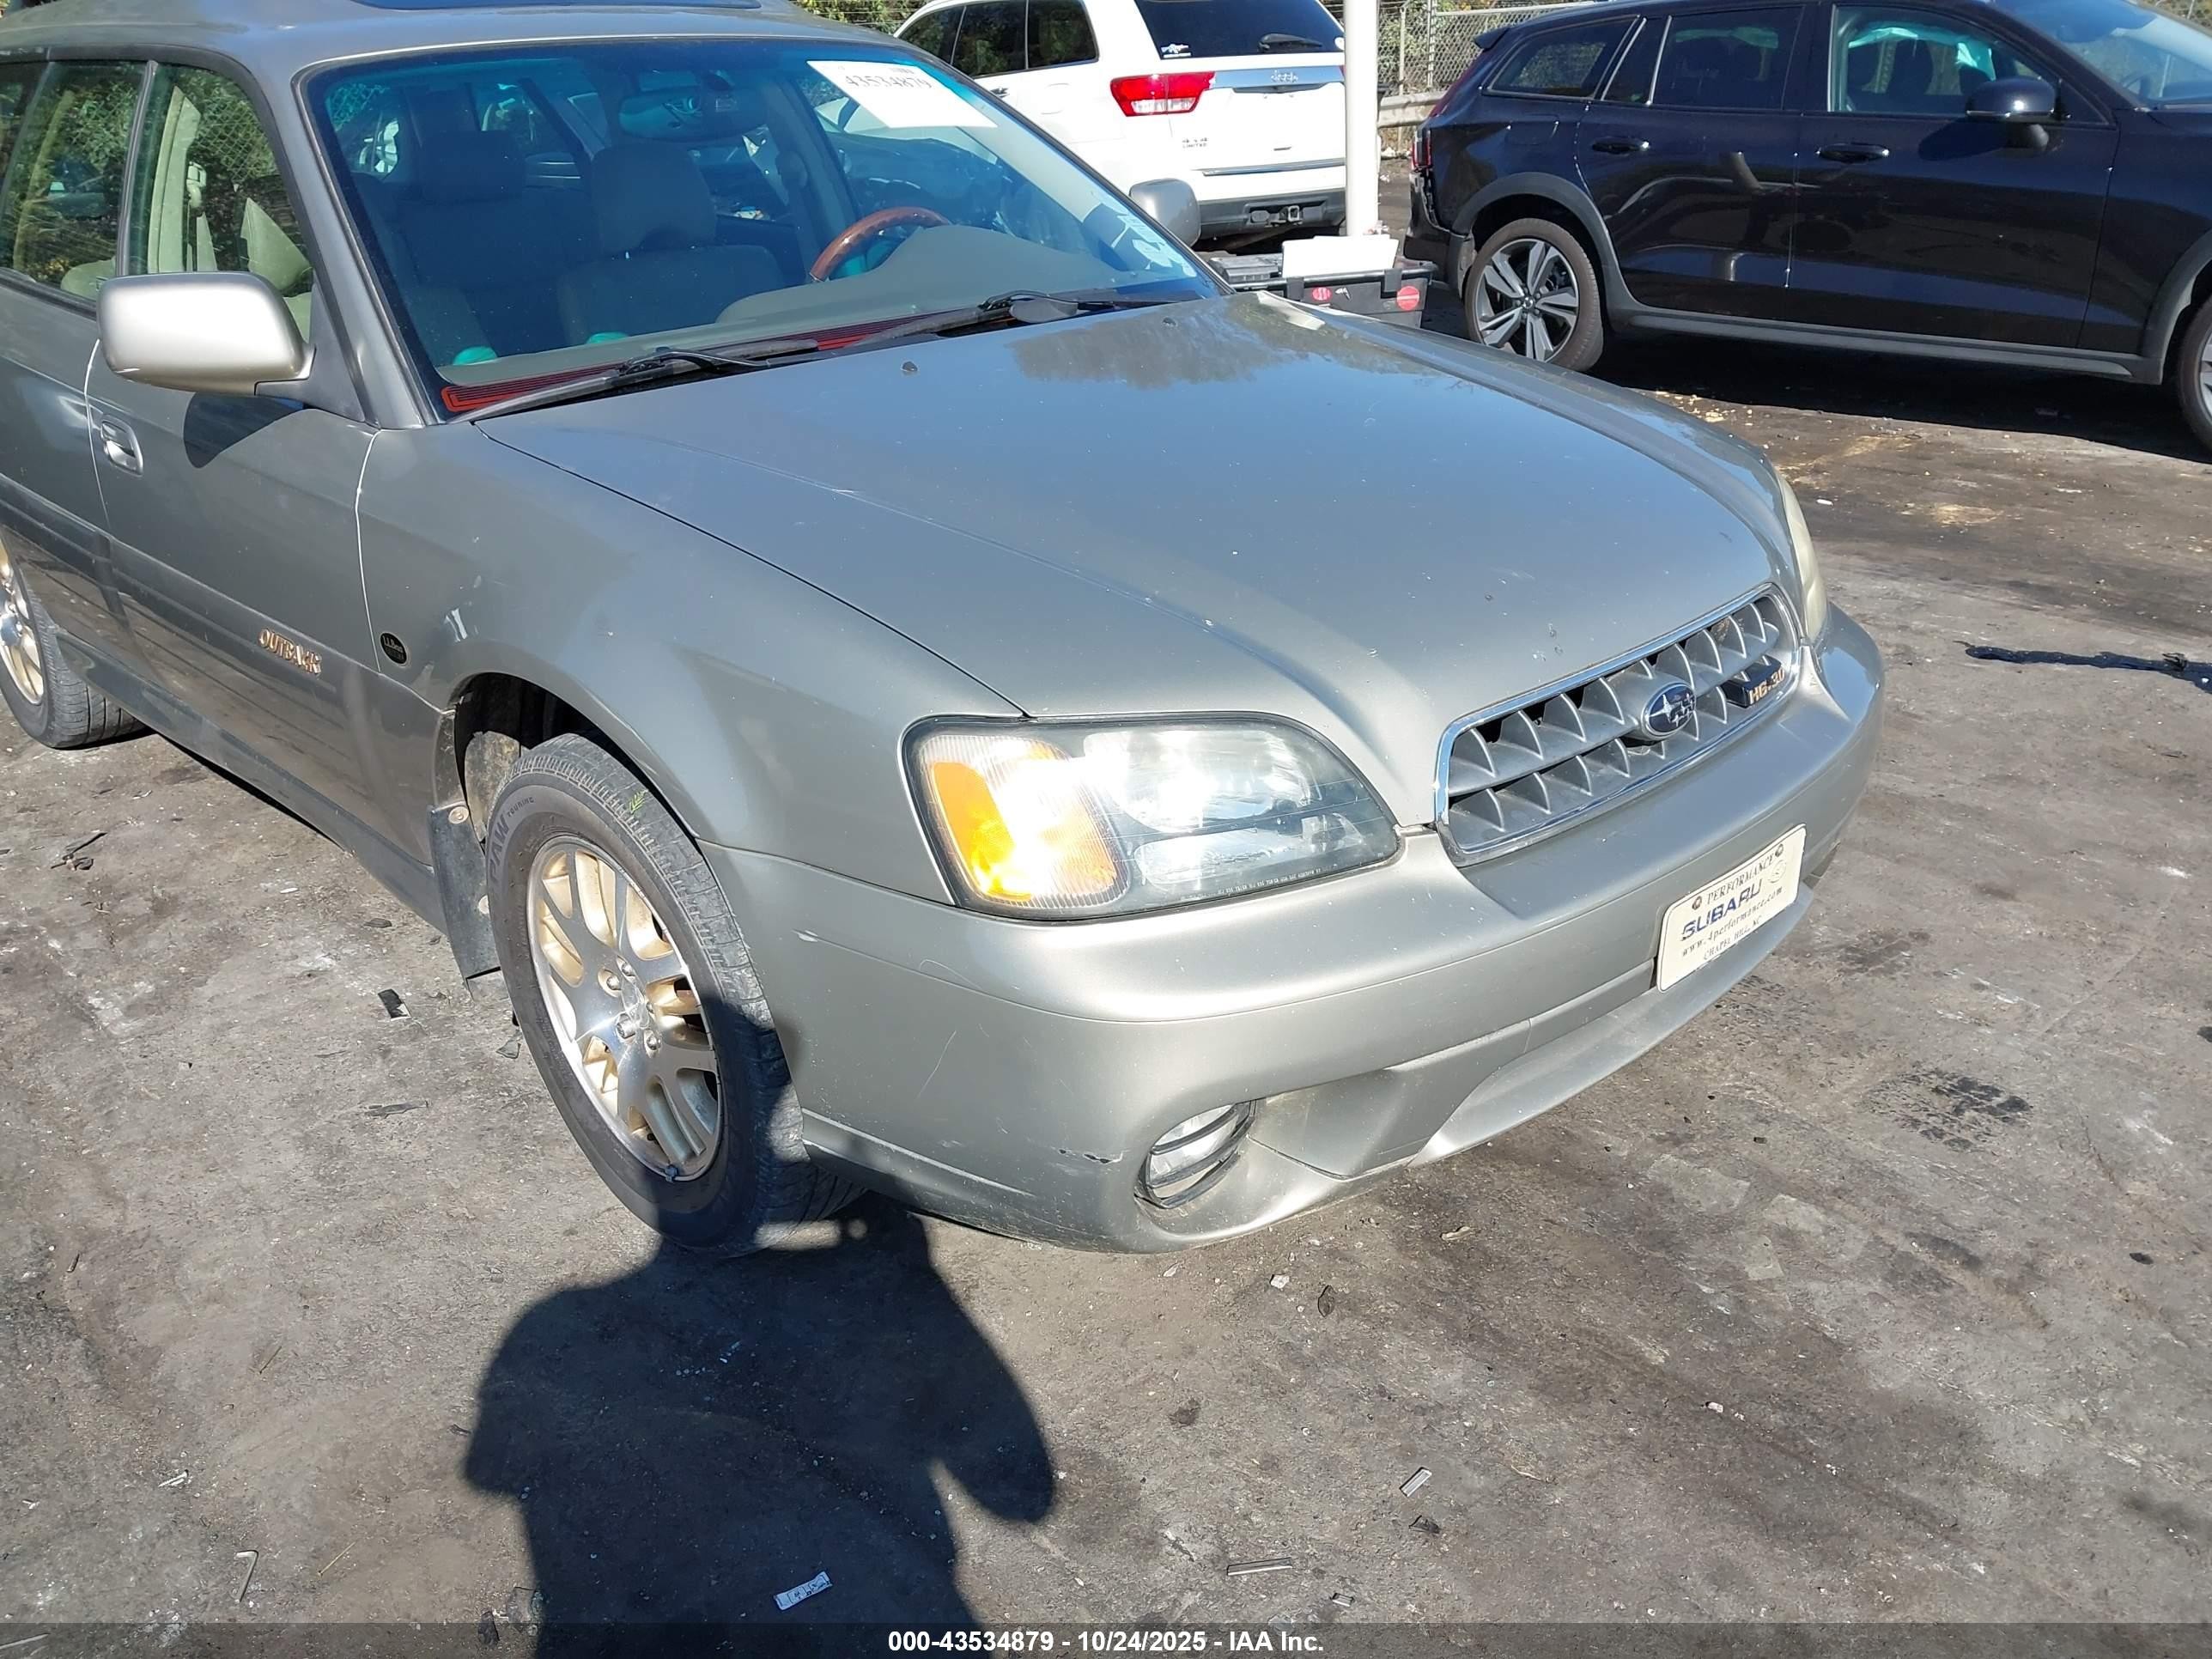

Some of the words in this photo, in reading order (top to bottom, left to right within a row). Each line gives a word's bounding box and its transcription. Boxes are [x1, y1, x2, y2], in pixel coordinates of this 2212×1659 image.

[846, 76, 932, 88] 43534879
[259, 628, 322, 675] OUTBACK
[507, 797, 534, 817] TOURING
[1707, 853, 1774, 905] PERFORMANCE
[1680, 878, 1762, 941] SUBARU
